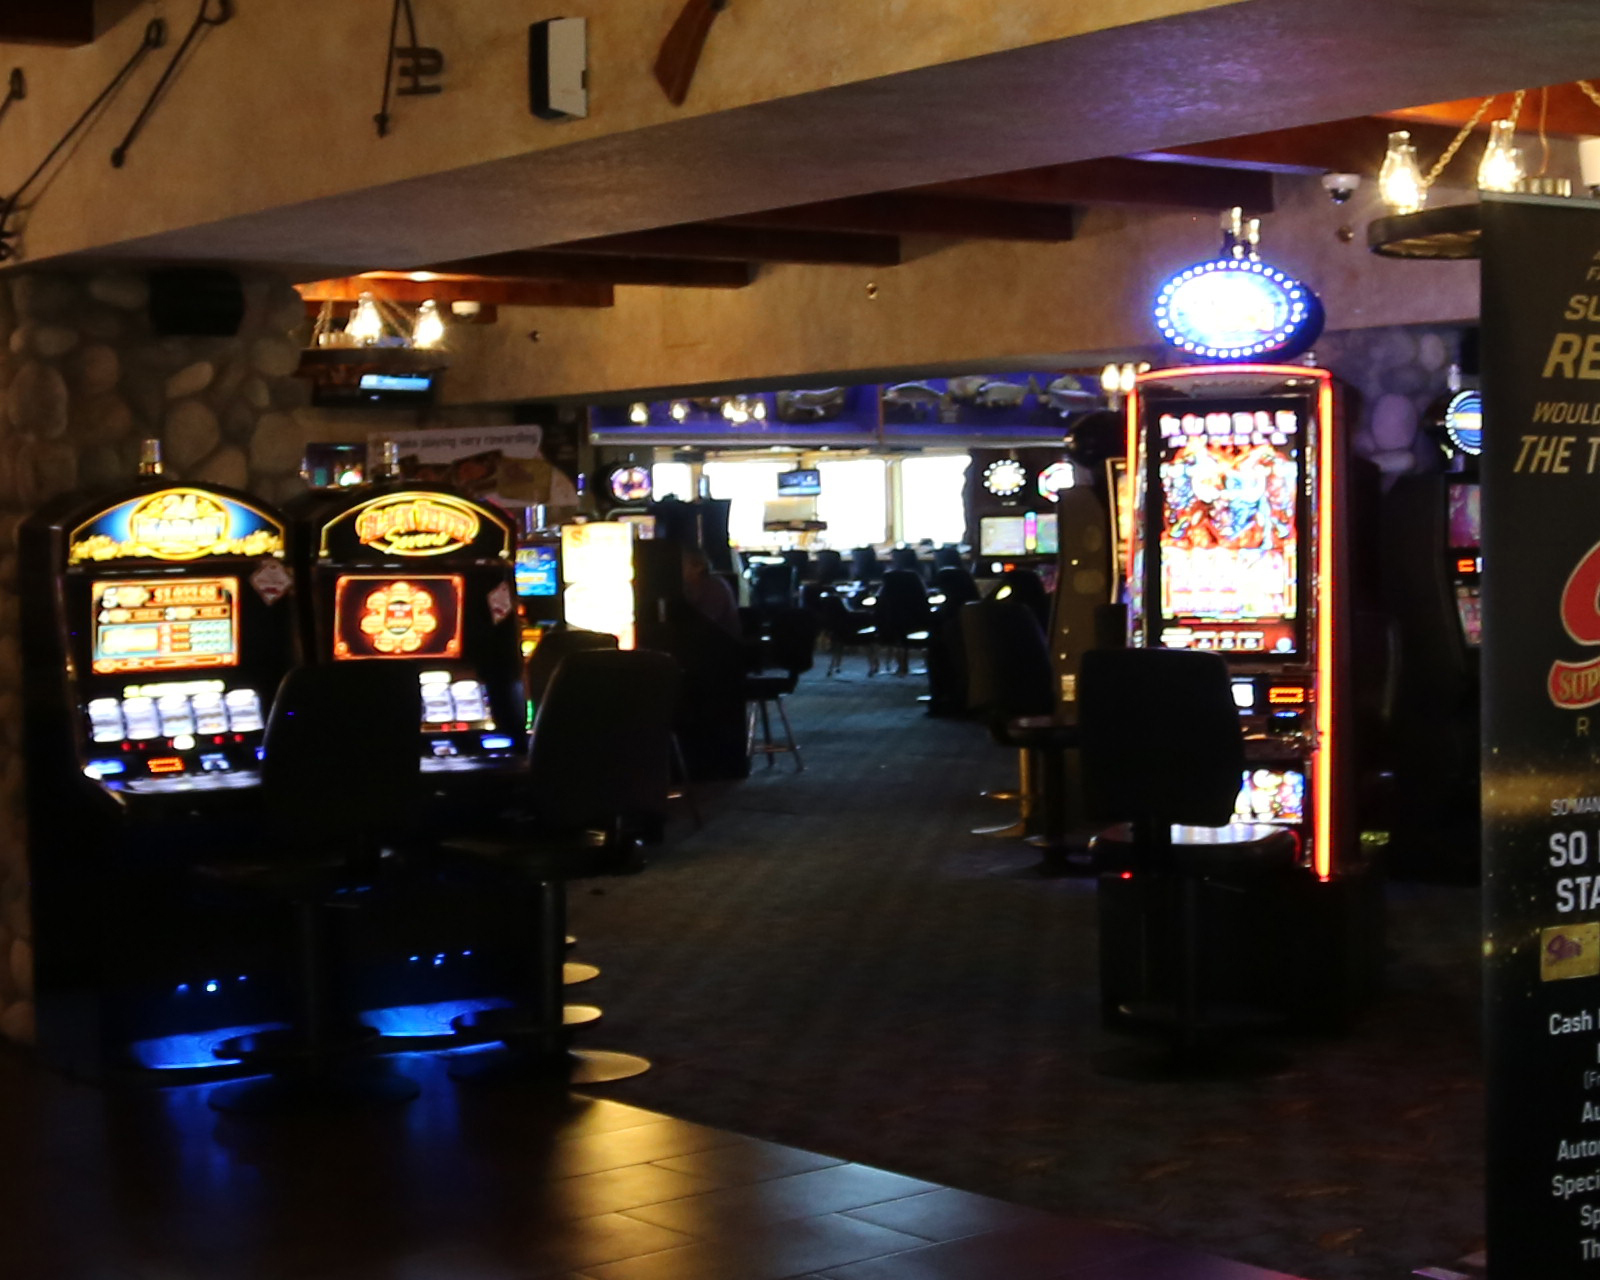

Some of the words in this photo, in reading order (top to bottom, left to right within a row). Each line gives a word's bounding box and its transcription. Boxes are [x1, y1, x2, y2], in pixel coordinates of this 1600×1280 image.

[1159, 410, 1298, 439] RUMBLE
[1513, 435, 1576, 474] THE
[103, 587, 117, 608] 5
[1551, 798, 1568, 817] SO
[1549, 830, 1588, 868] SO
[1549, 1010, 1593, 1035] Cash
